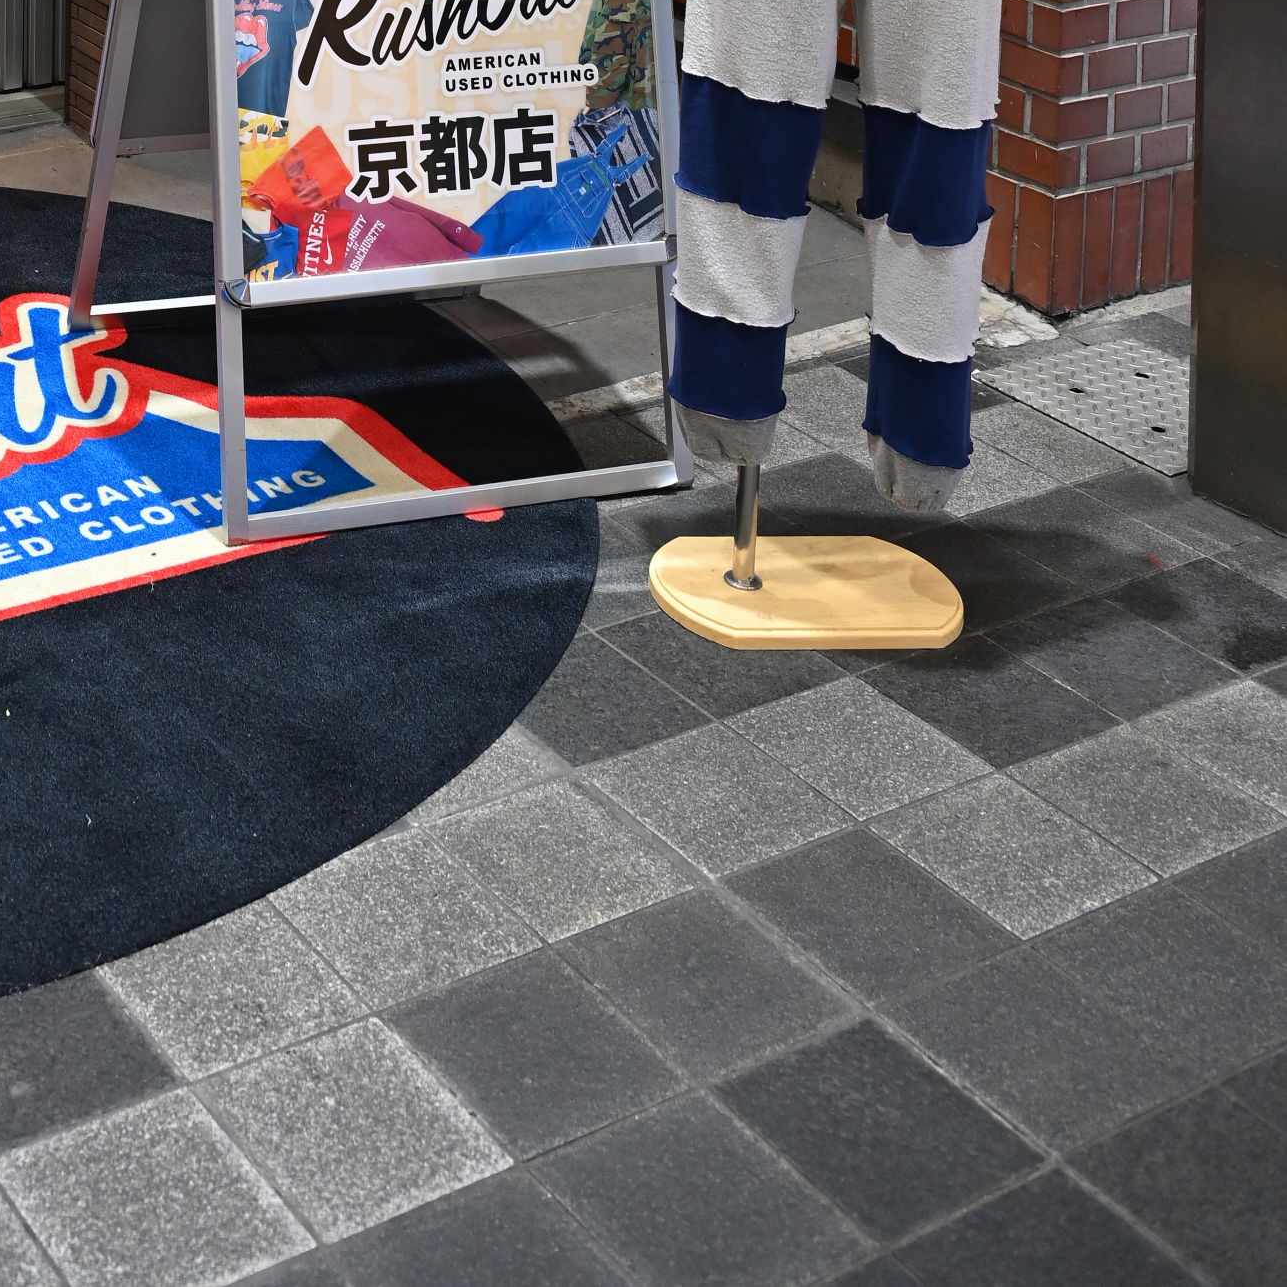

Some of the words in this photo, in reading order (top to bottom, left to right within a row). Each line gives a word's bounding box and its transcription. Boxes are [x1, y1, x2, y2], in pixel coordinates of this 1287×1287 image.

[445, 53, 542, 72] AMERICAN
[445, 77, 494, 92] USED
[502, 68, 595, 88] CLOTHING
[348, 107, 556, 199] 京都店
[347, 219, 386, 274] ASSACHUSETTS
